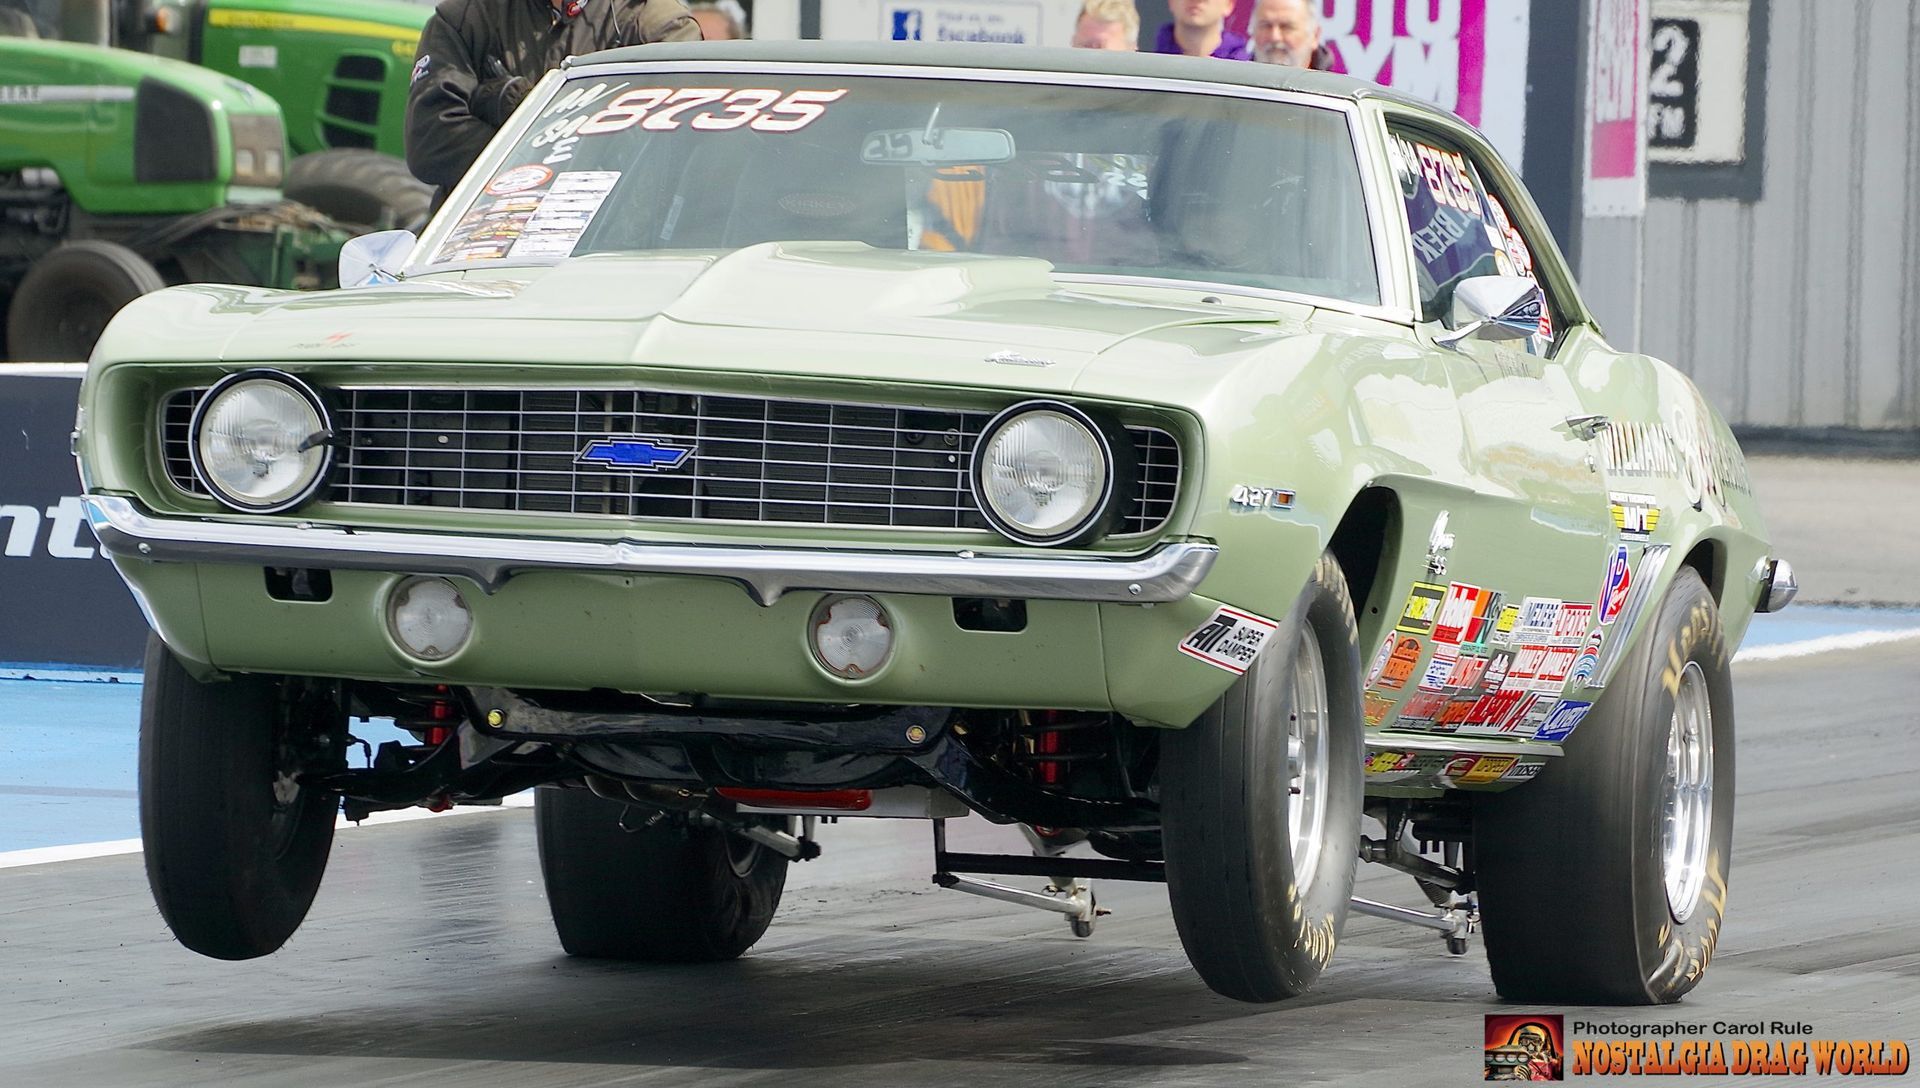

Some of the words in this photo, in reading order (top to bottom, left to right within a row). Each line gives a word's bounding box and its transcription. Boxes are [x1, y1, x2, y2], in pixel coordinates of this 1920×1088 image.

[576, 87, 851, 135] 8735
[1231, 484, 1274, 508] 427
[1232, 626, 1265, 647] SUPER
[1215, 639, 1257, 663] DAMPER
